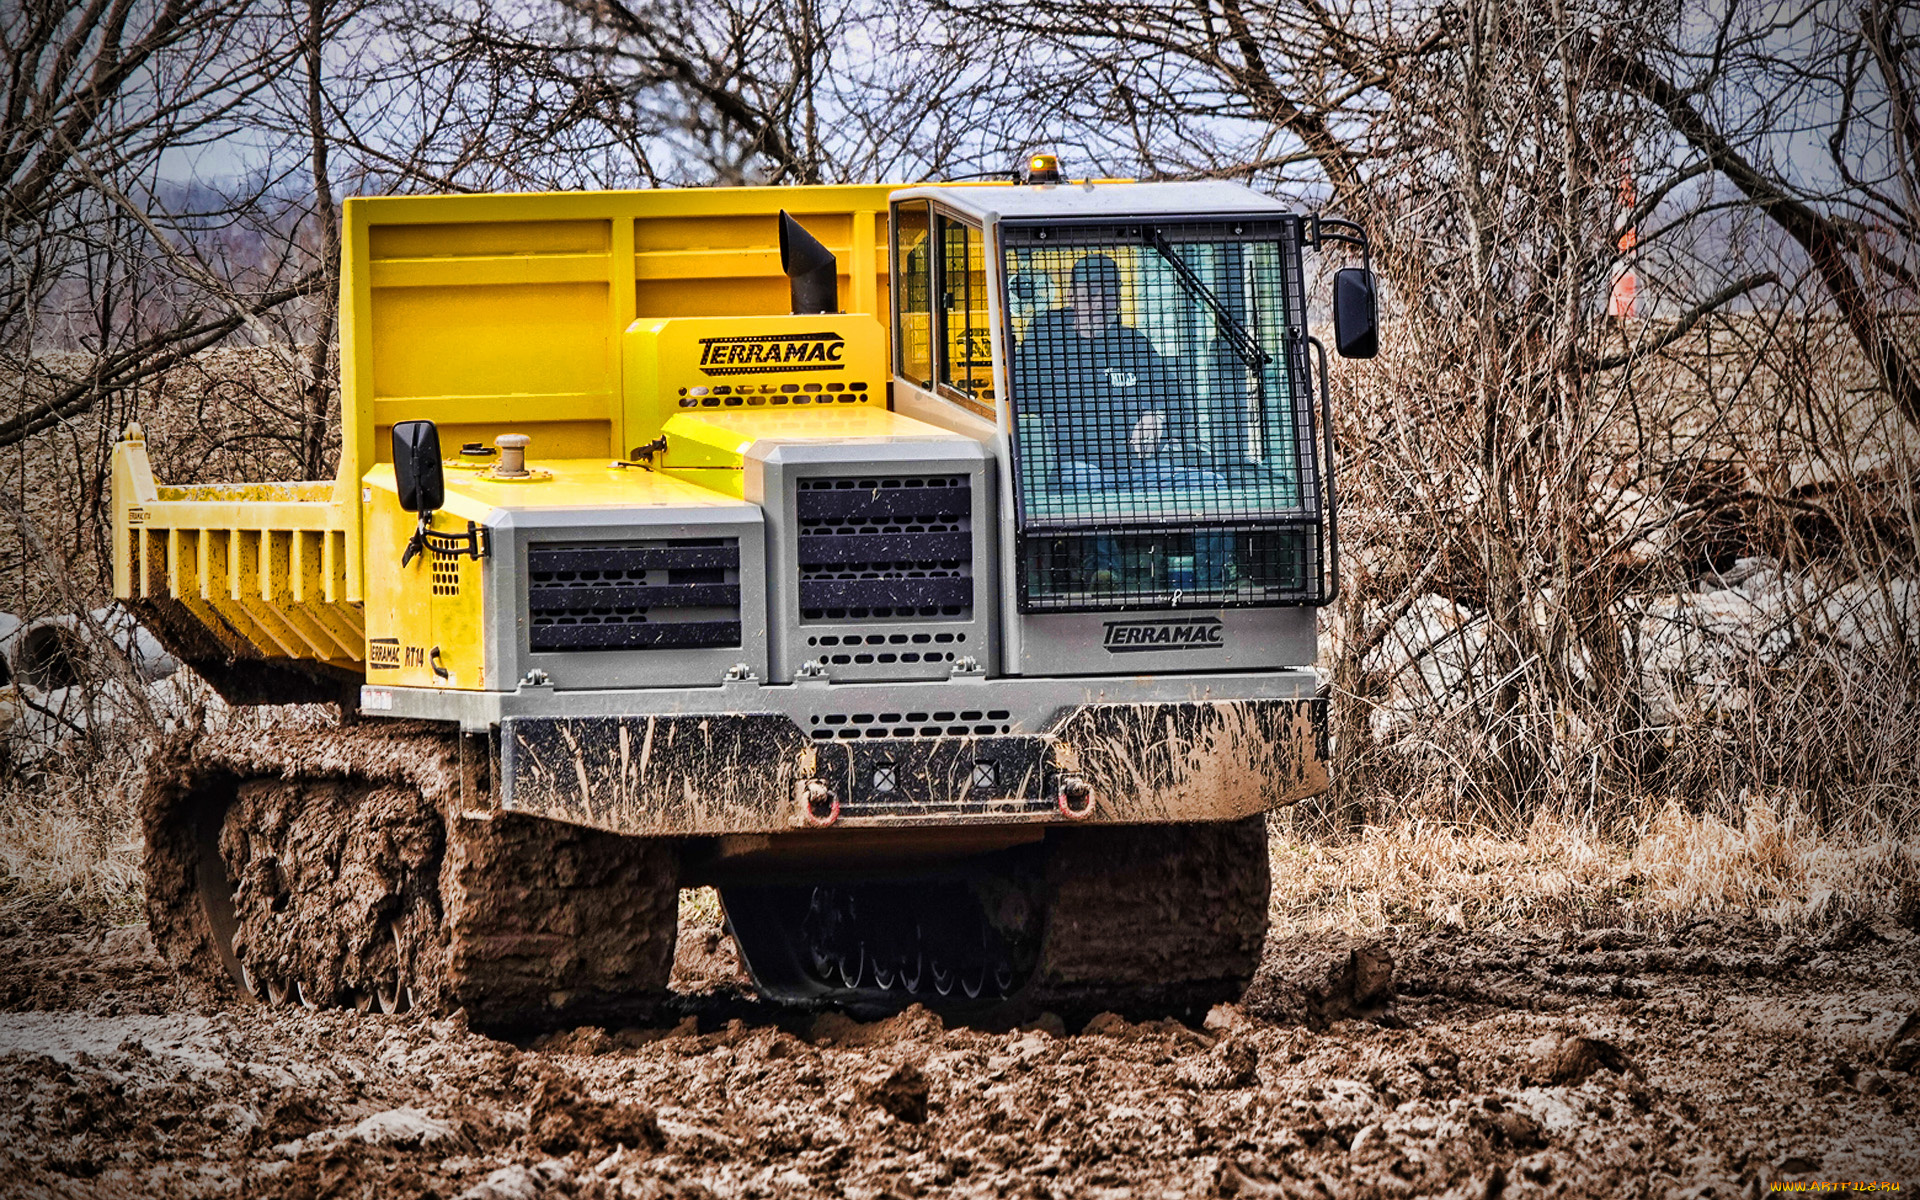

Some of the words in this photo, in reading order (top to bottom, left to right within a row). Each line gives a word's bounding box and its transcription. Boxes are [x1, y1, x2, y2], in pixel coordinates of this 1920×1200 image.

[699, 338, 844, 366] TERRAMAC
[1103, 621, 1223, 645] TERRAMAC
[405, 646, 424, 667] RT14
